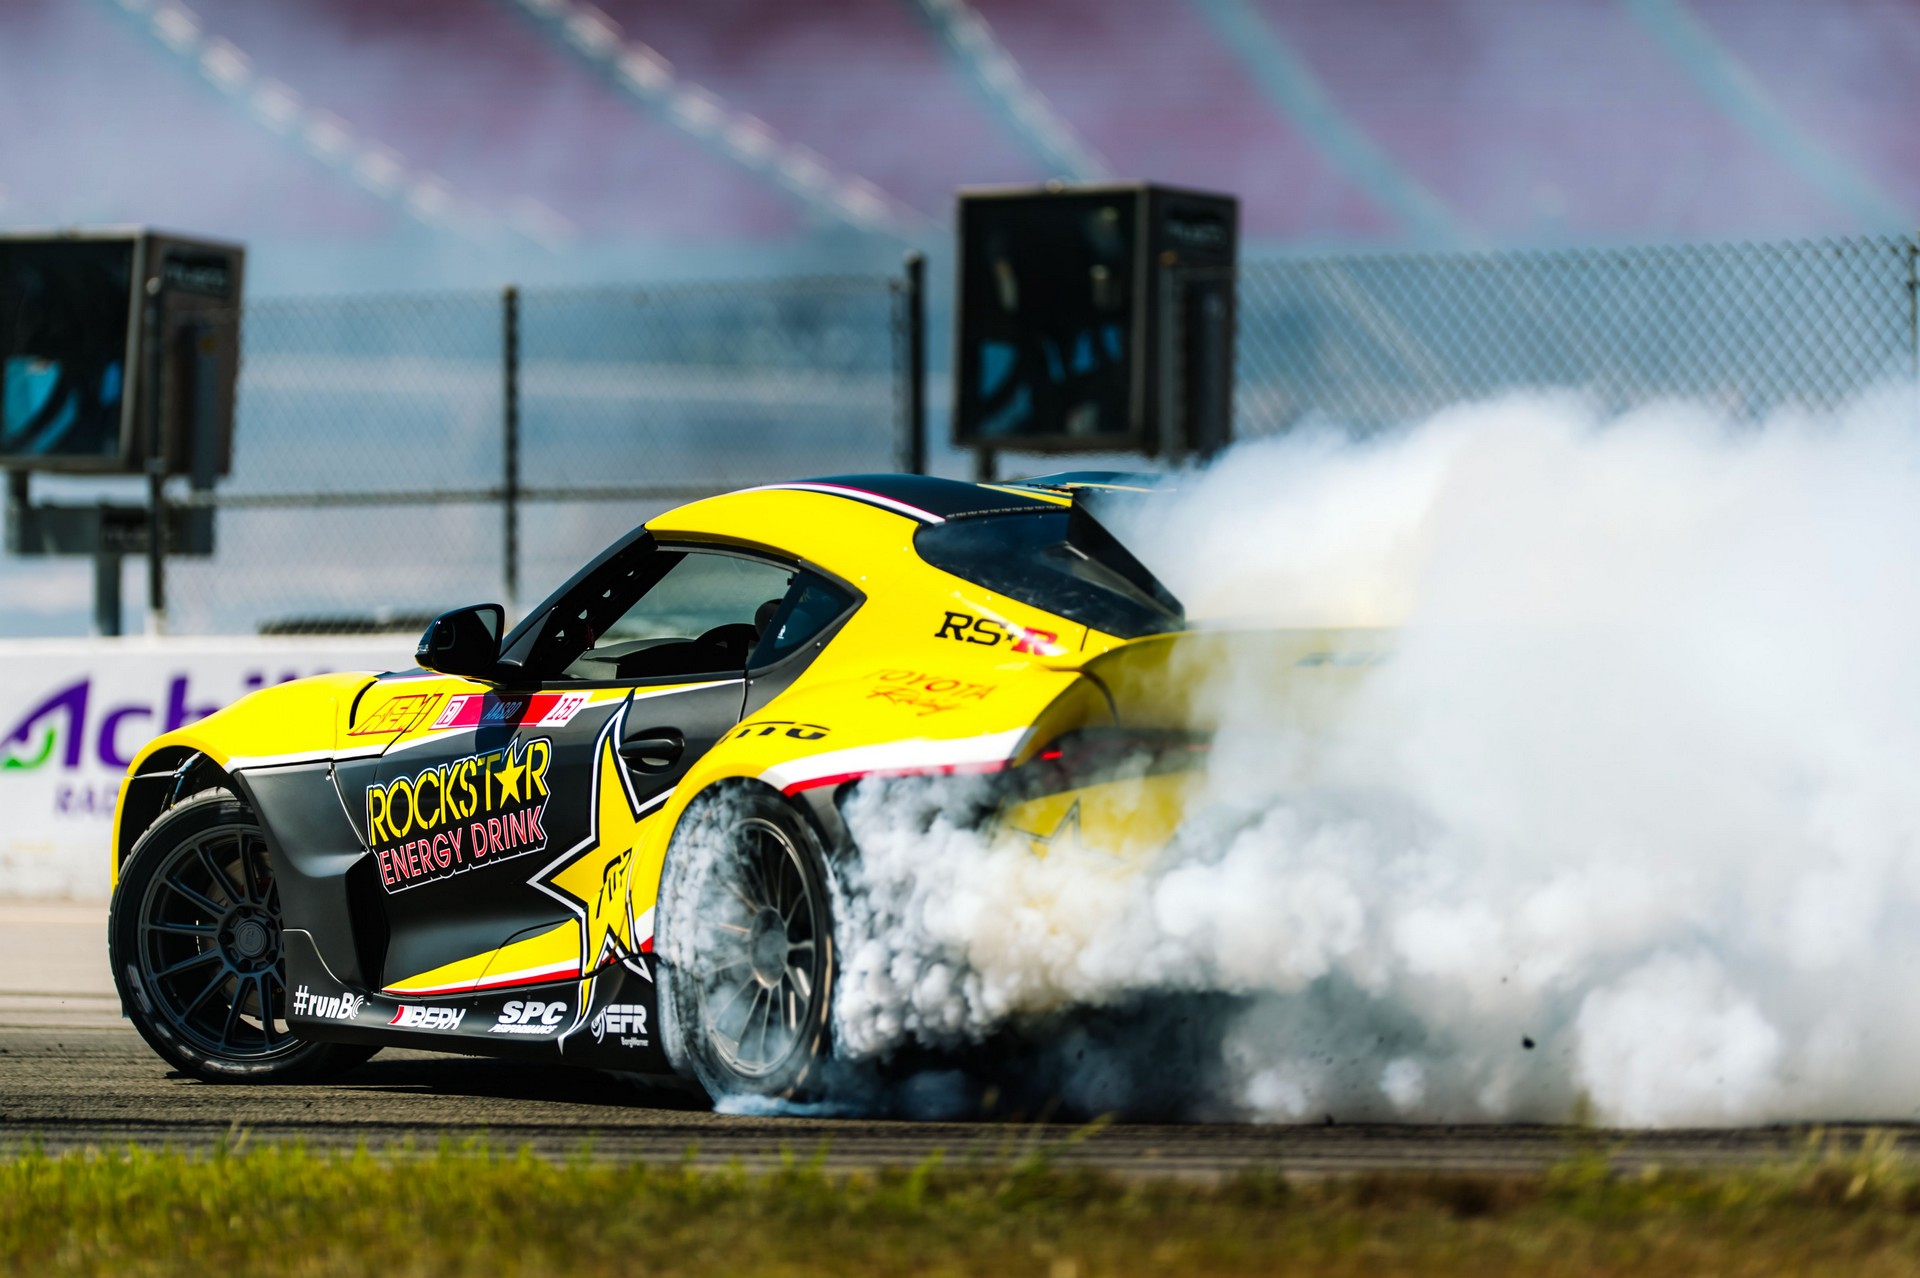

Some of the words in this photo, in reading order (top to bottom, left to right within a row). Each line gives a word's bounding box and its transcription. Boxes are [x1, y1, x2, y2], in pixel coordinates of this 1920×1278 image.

[862, 669, 997, 699] TOYOTA
[547, 698, 584, 721] 151
[379, 828, 463, 885] ENERGY
[471, 805, 544, 858] DRINK
[498, 1000, 567, 1025] SPC
[606, 1004, 648, 1034] EFR
